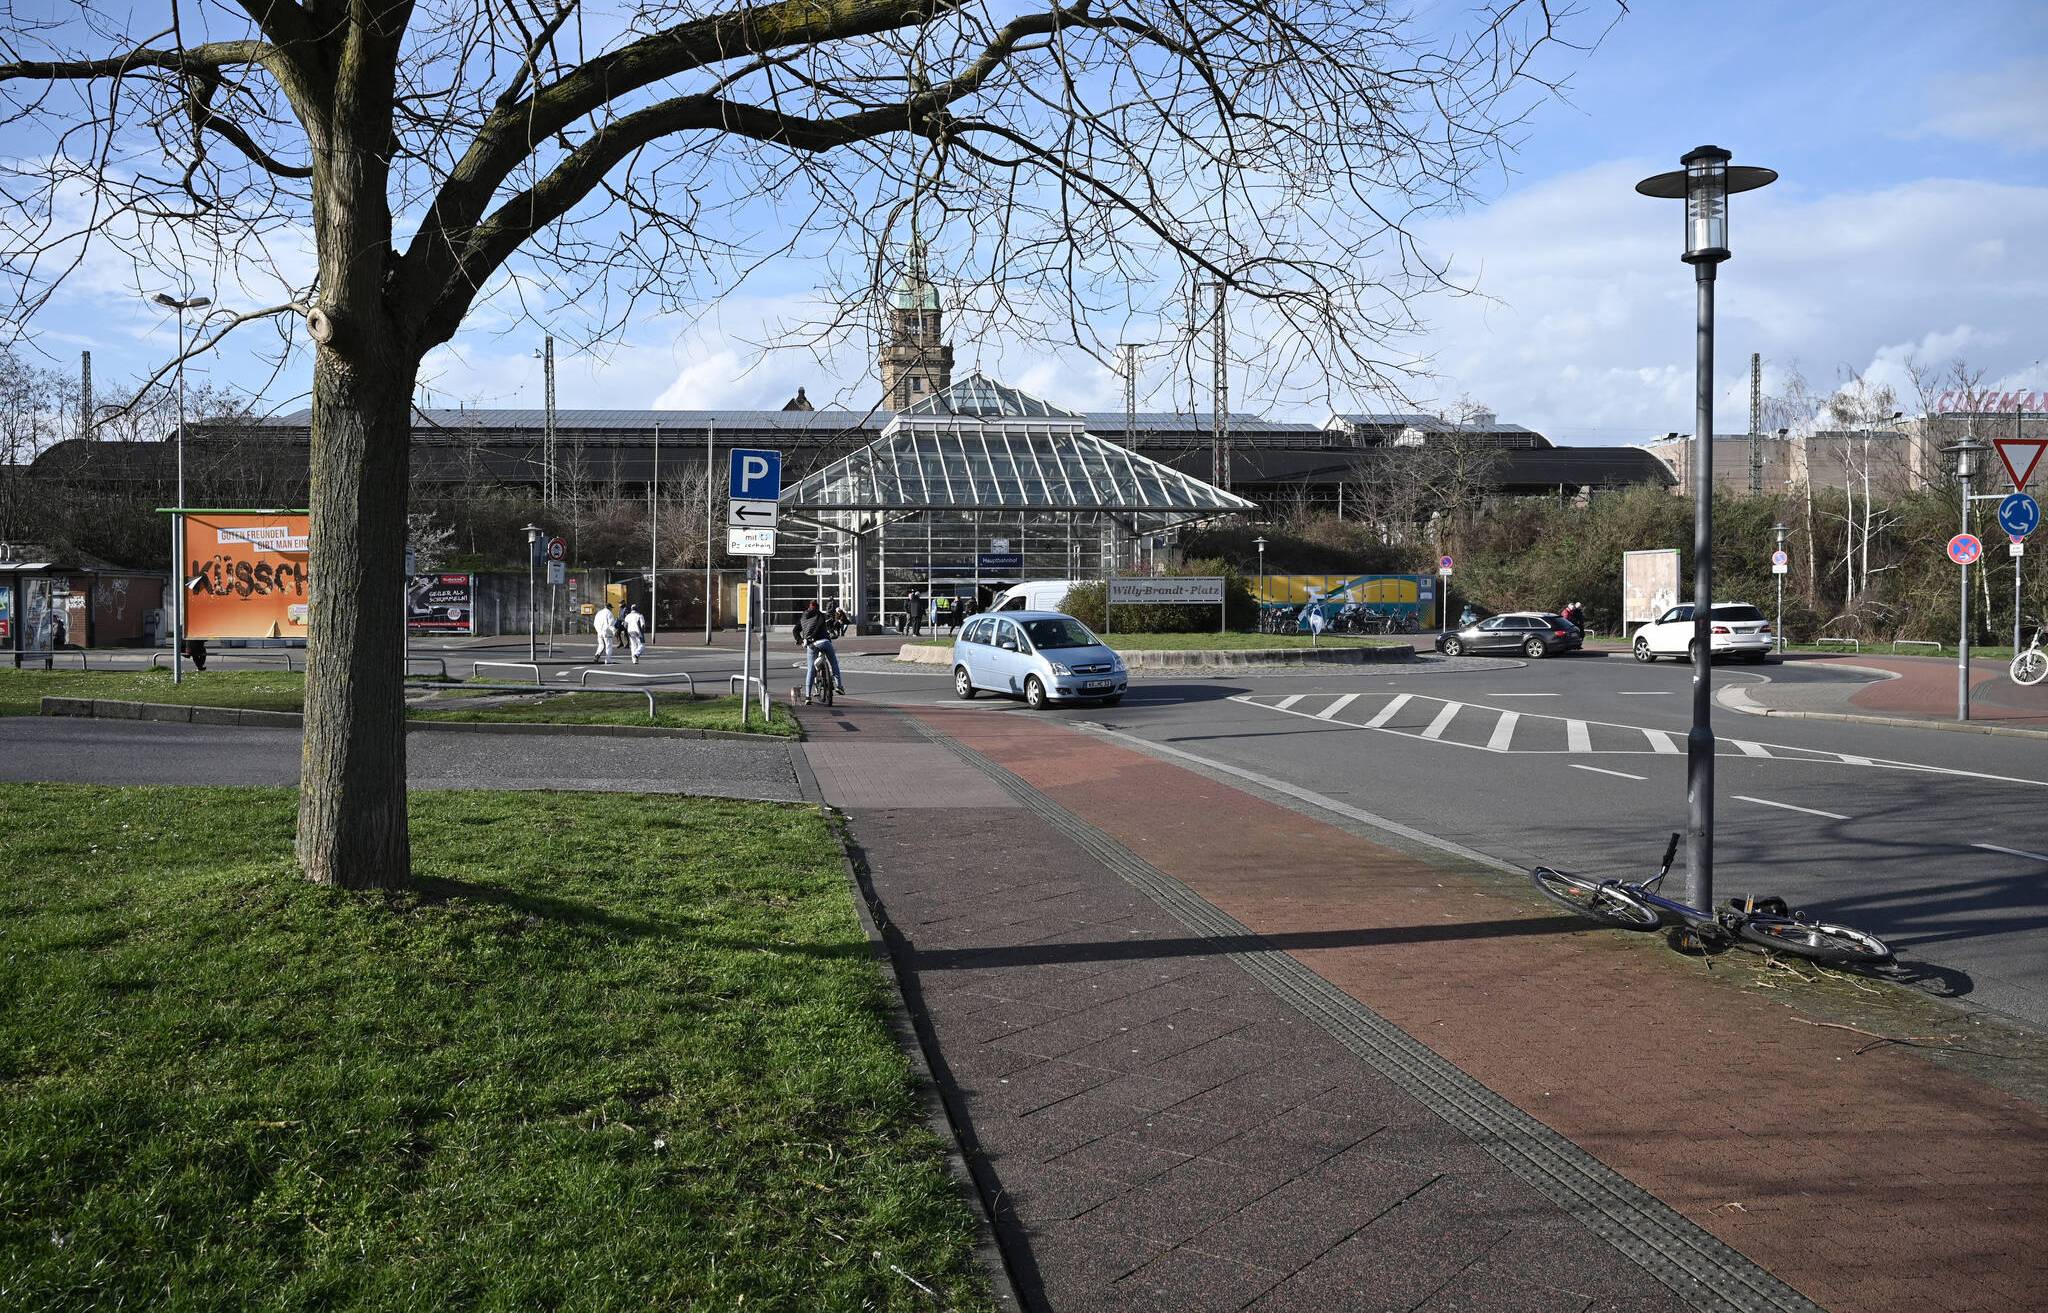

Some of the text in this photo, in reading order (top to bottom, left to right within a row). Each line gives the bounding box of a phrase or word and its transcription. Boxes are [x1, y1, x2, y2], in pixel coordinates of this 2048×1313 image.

[742, 456, 769, 492] P
[221, 529, 285, 541] GUTEN FREUNDEN
[257, 540, 273, 550] GIBT
[276, 540, 292, 549] MAN
[982, 557, 1018, 565] Hauptbahnhof
[1112, 585, 1220, 597] Willy-Brandt-Platz
